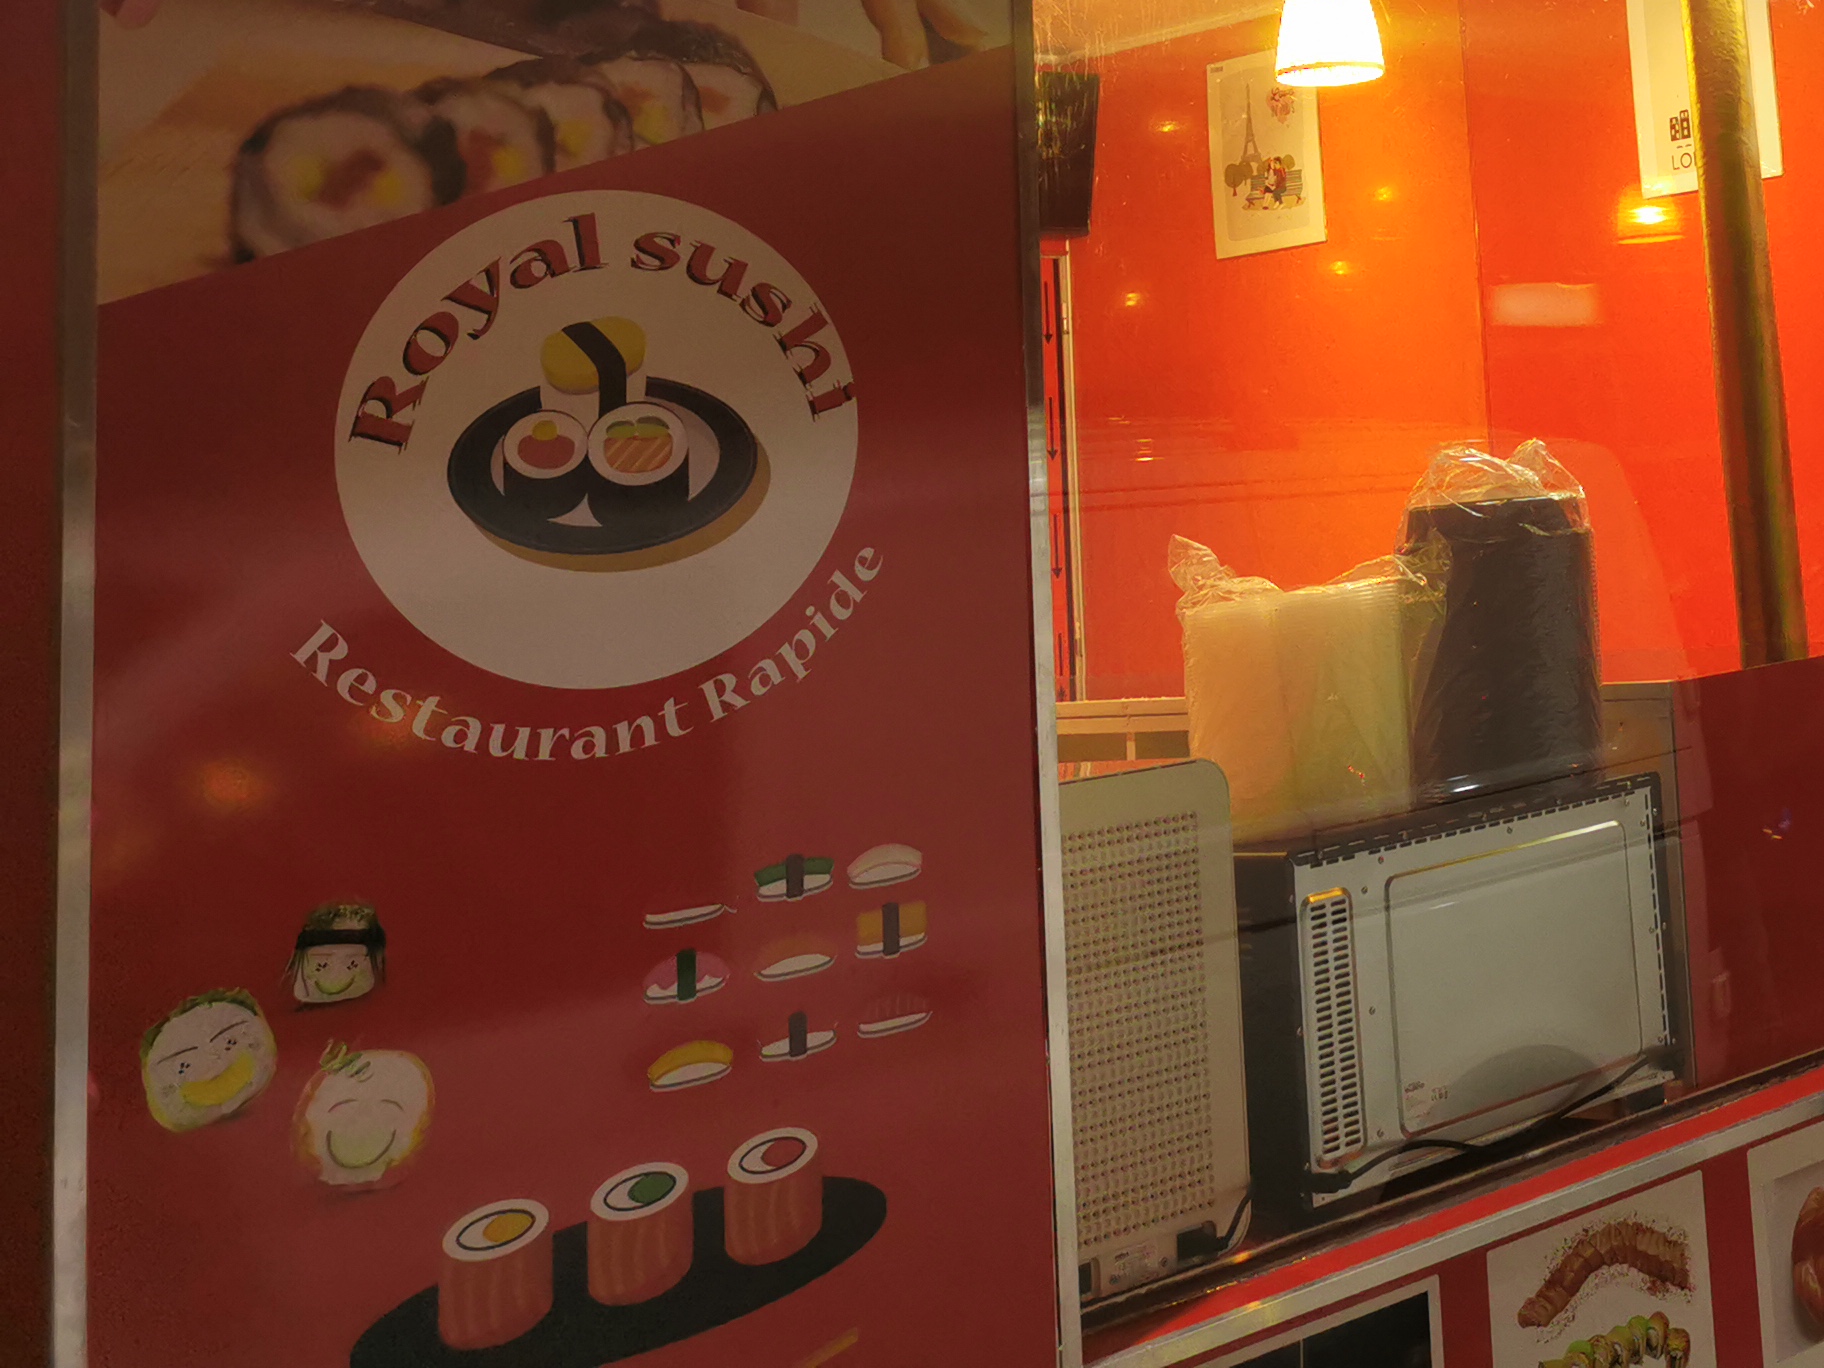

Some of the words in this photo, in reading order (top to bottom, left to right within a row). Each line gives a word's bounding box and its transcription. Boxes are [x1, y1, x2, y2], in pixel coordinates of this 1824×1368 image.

[348, 212, 609, 454] Royal
[628, 229, 856, 423] sushi
[289, 619, 694, 761] Restaurant
[698, 545, 884, 723] Rapide
